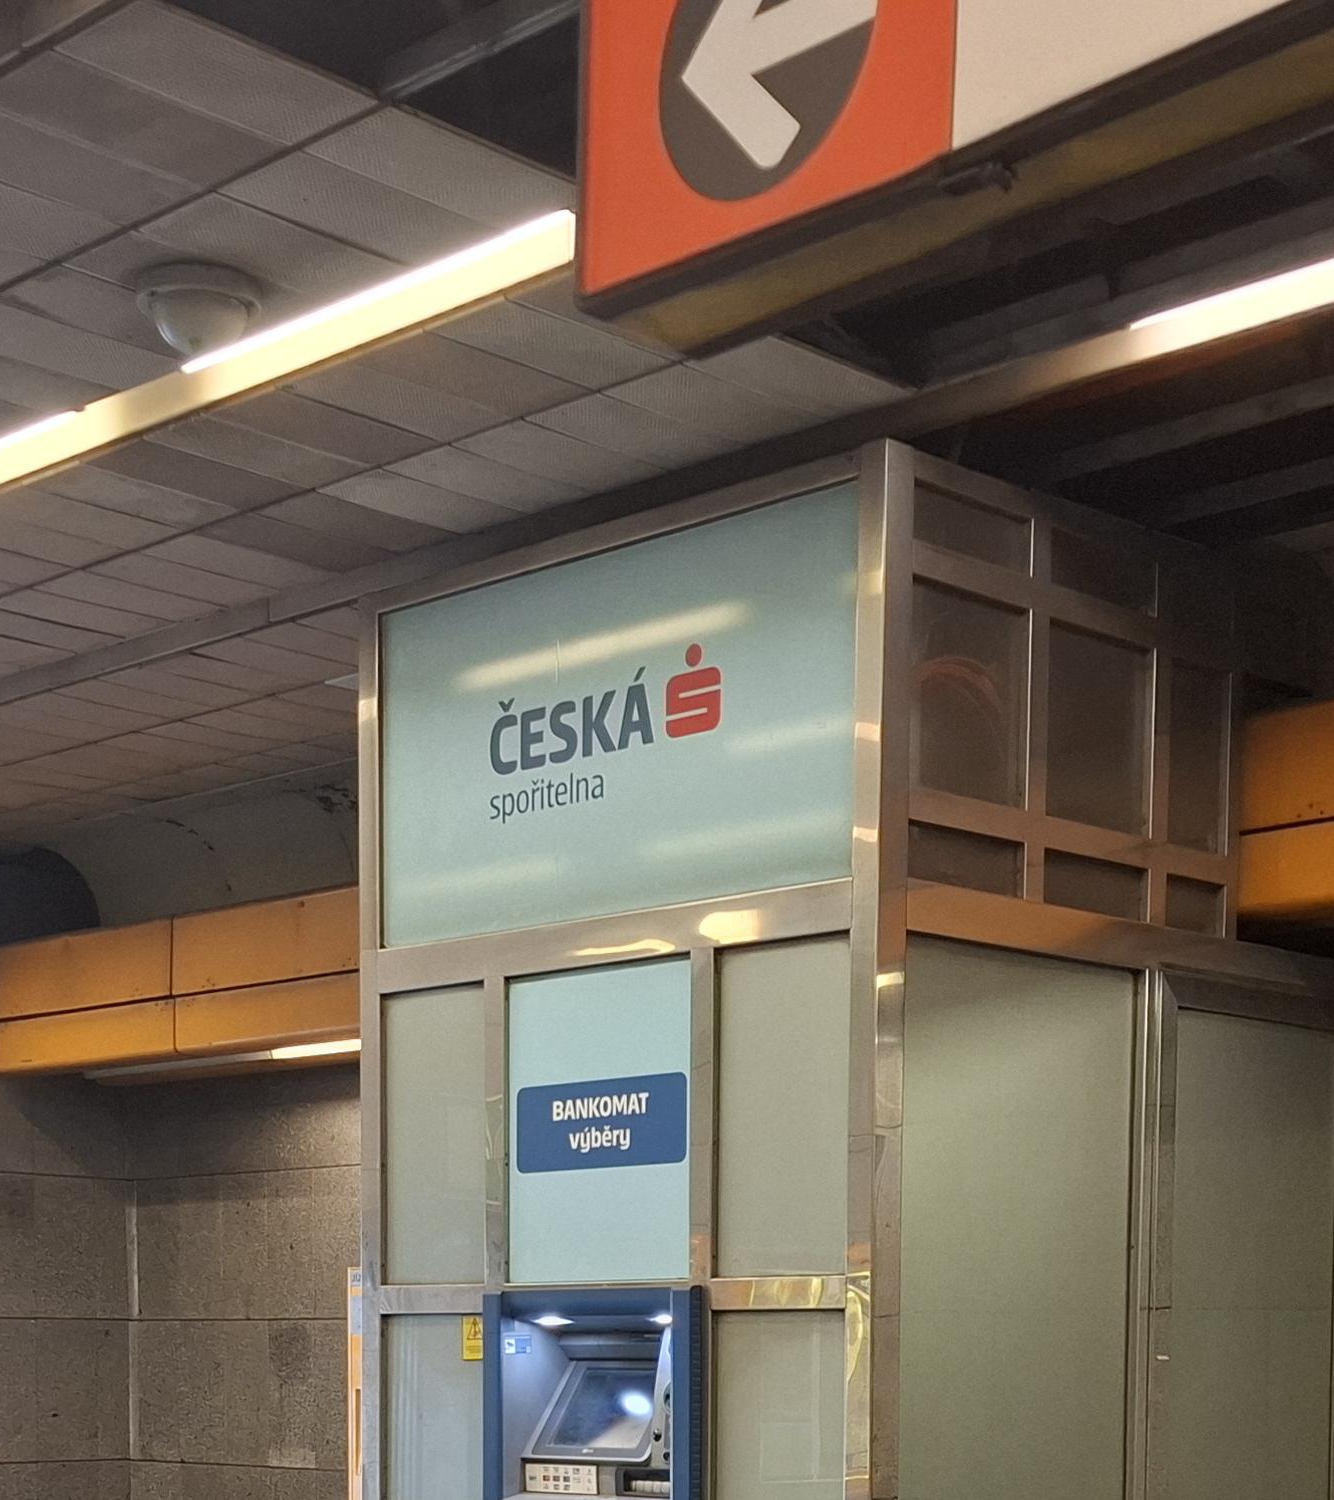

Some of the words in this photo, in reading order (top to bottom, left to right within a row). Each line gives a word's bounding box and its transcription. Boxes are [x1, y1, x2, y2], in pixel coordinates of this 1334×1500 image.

[489, 666, 655, 776] ČESKÁ
[489, 772, 605, 824] spořitelna
[552, 1092, 650, 1122] BANKOMAT
[569, 1125, 631, 1153] výběry
